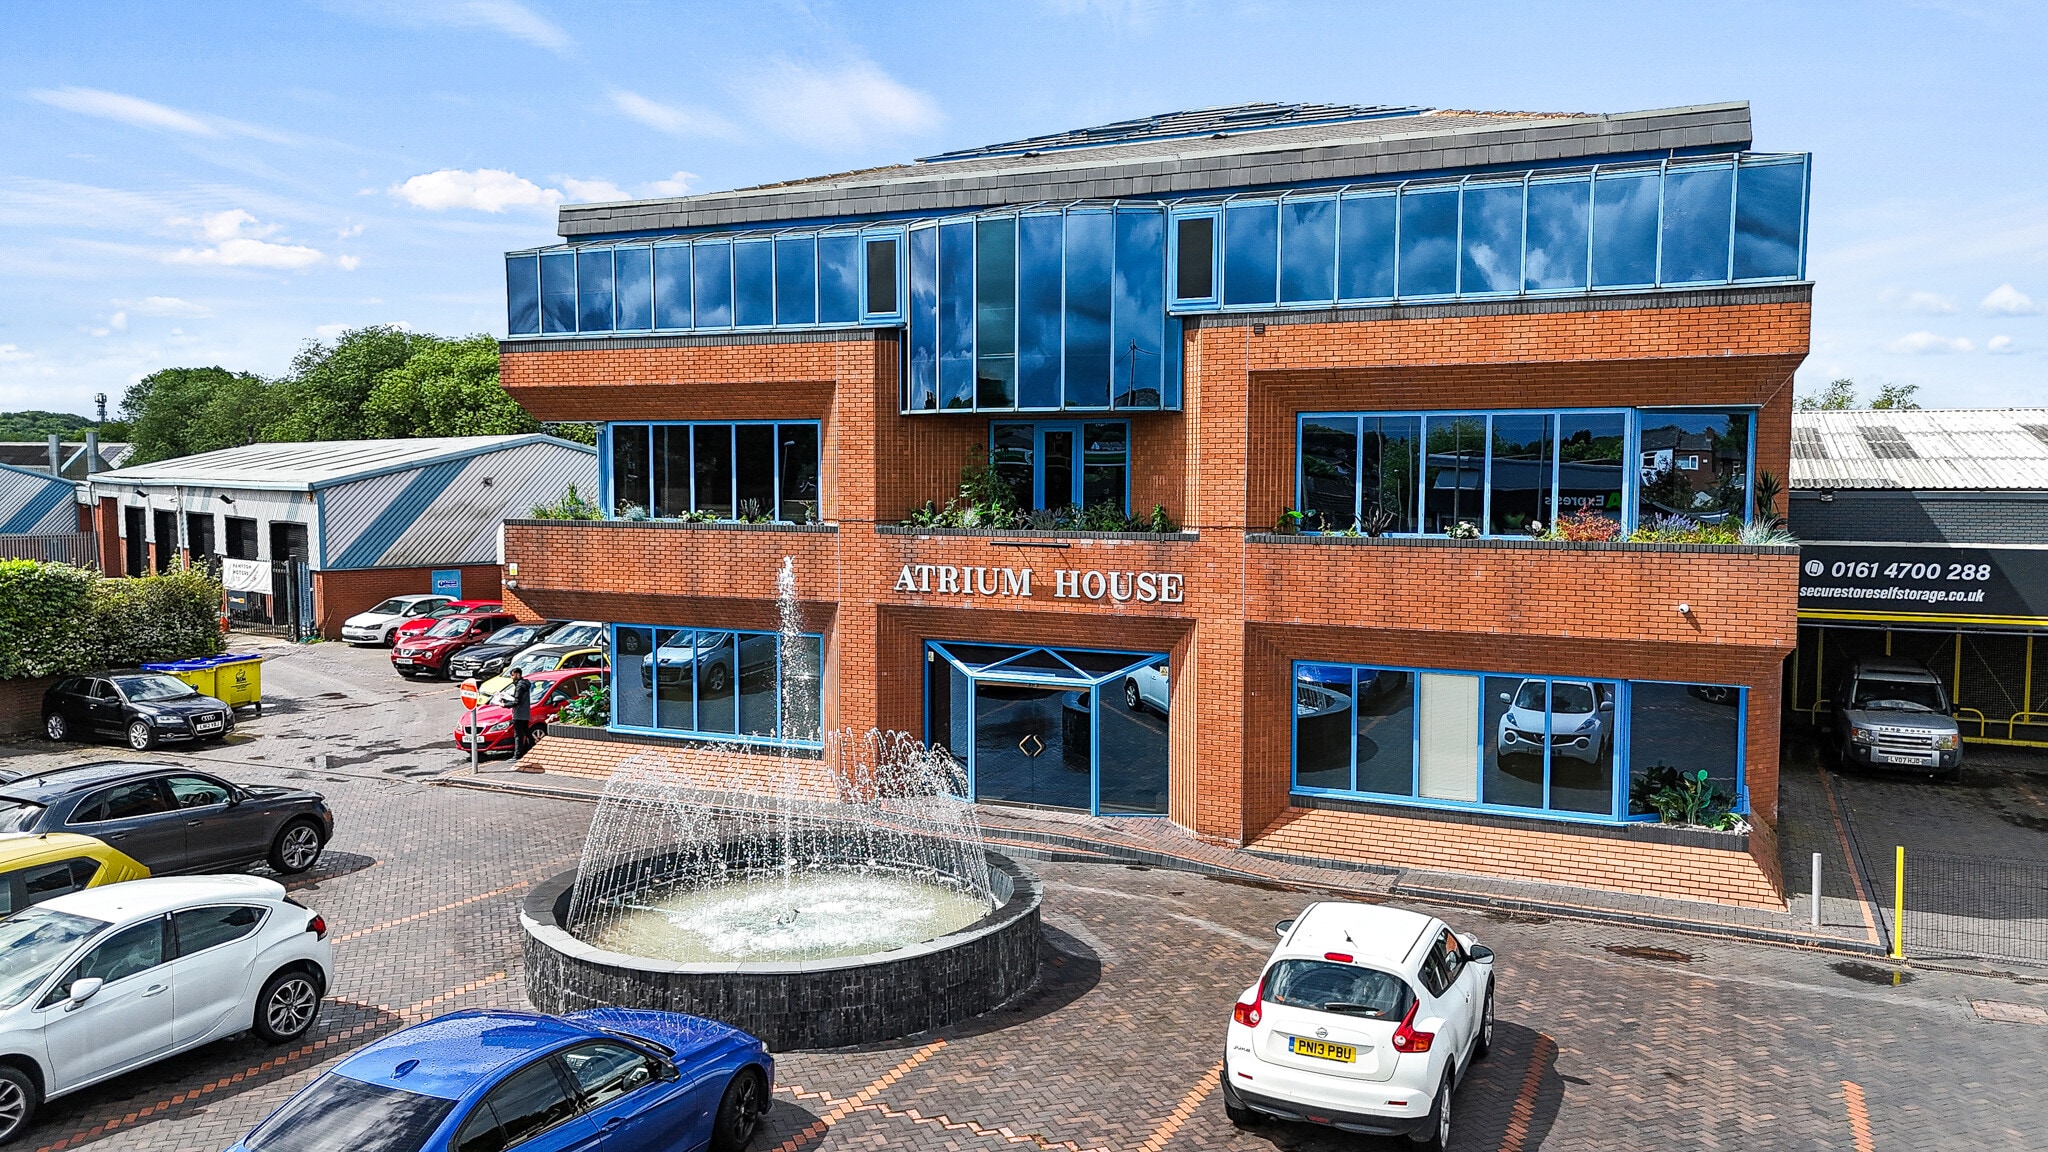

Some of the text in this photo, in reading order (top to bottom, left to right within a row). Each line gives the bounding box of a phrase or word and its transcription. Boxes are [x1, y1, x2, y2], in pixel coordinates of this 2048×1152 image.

[1831, 561, 1991, 581] 0161 4700 288
[893, 564, 1184, 603] ATRIUM HOUSE
[1799, 586, 1985, 604] securestoreselfstorage.co.uk
[1298, 1040, 1352, 1060] PN13 PBU
